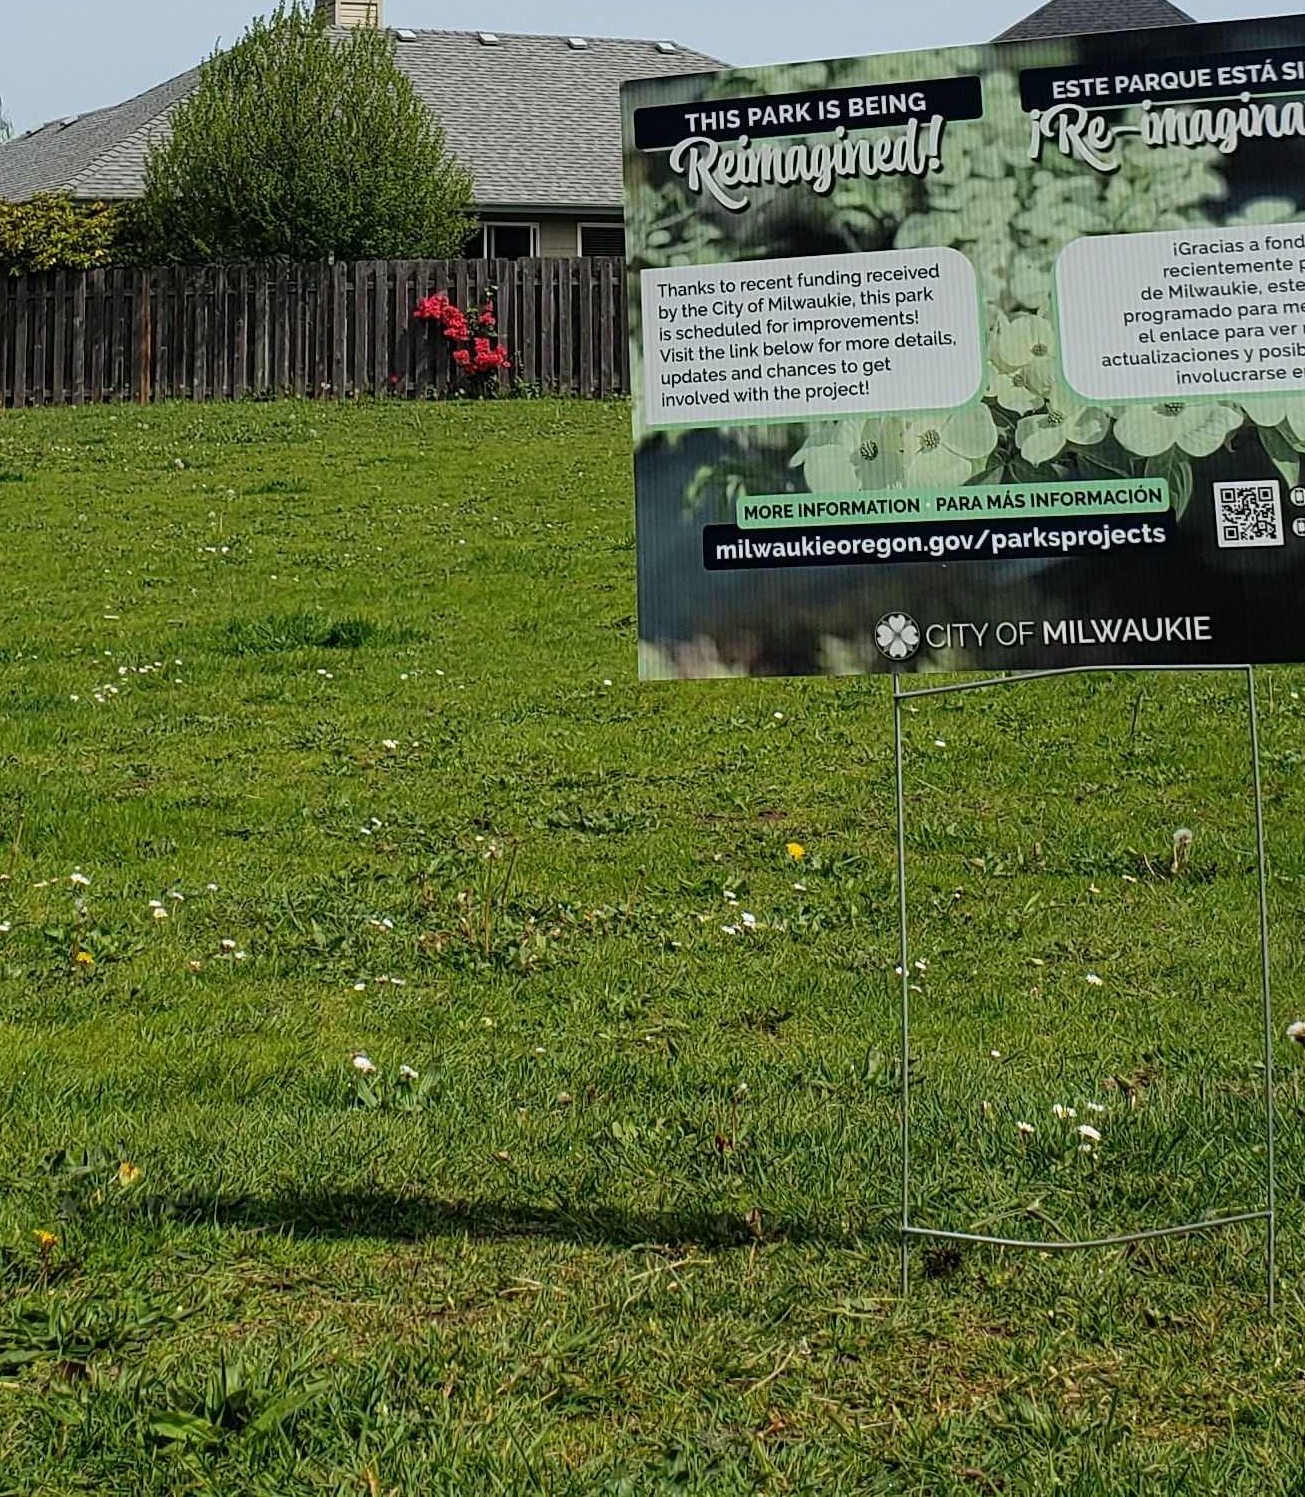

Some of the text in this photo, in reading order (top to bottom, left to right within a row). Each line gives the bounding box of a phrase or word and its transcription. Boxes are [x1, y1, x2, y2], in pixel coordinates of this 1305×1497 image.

[1052, 76, 1110, 99] ESTE
[1114, 68, 1213, 94] PARQUE
[1217, 58, 1278, 86] ESTÁ
[684, 92, 927, 133] THIS PARK IS BEING
[669, 115, 943, 209] Reimagined!
[1173, 239, 1244, 257] ¡Gracias
[1249, 240, 1260, 252] a
[657, 263, 940, 298] Thanks to recent funding received
[1163, 257, 1294, 278] recientemente
[658, 286, 934, 323] by the City of Milwaukie, this park
[1141, 286, 1164, 301] de
[1168, 280, 1262, 299] Milwaukie,
[1267, 278, 1305, 293] este
[659, 309, 919, 342] is scheduled for improvements!
[1123, 303, 1232, 327] programado
[1237, 304, 1278, 321] para
[659, 330, 956, 363] Visit the link below for more details,
[1138, 328, 1156, 344] el
[1159, 326, 1220, 342] enlace
[1225, 326, 1265, 343] para
[1268, 324, 1298, 336] ver
[661, 356, 892, 389] updates and chances to get
[1101, 347, 1239, 367] actualizaciones
[1243, 348, 1254, 364] y
[1176, 368, 1287, 385] involucrarse
[661, 380, 870, 408] involved with the project!
[744, 485, 1163, 521] MORE INFORMATION PARA MÁS INFORMACIÓN
[715, 523, 1167, 560] milwaukieoregon.gov/parksprojects
[925, 615, 1213, 648] CITY OF MILWAUKIE
